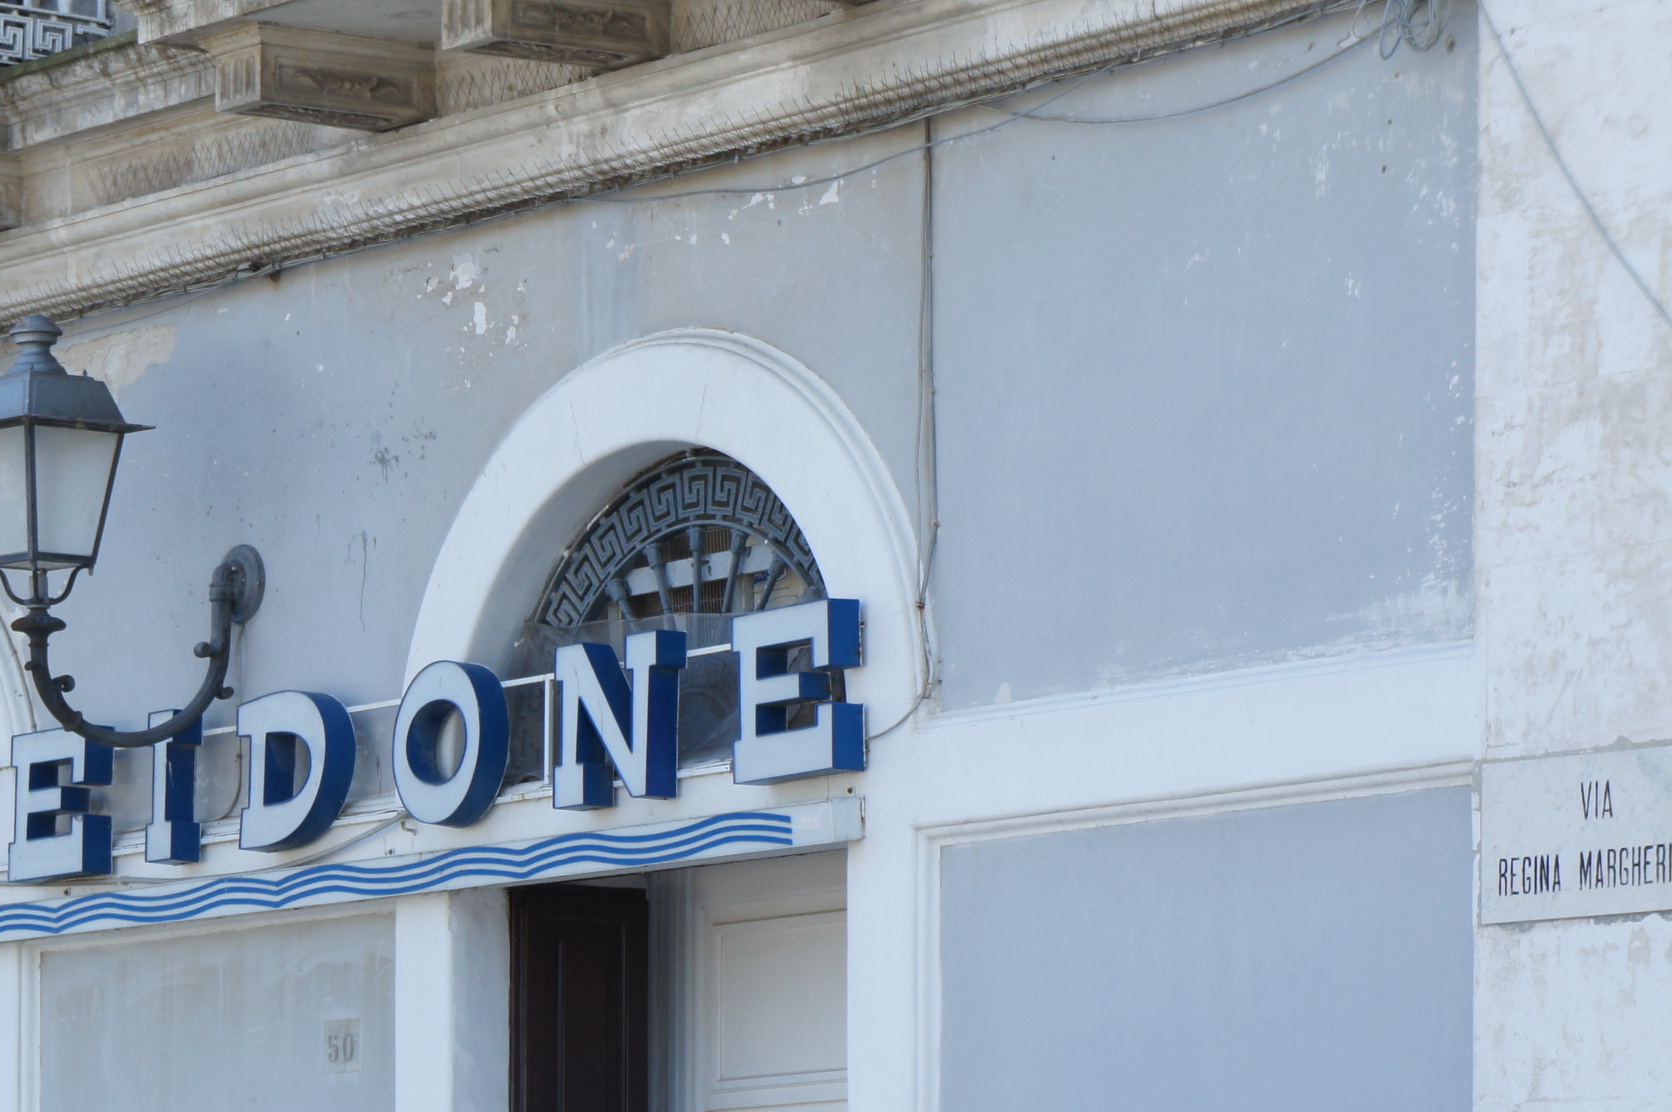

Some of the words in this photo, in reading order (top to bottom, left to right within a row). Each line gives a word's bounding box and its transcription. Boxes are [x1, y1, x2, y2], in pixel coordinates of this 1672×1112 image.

[1580, 779, 1613, 820] VIA
[1498, 854, 1561, 897] REGINA
[1579, 842, 1672, 891] MARGHERI
[327, 1032, 354, 1063] 50
